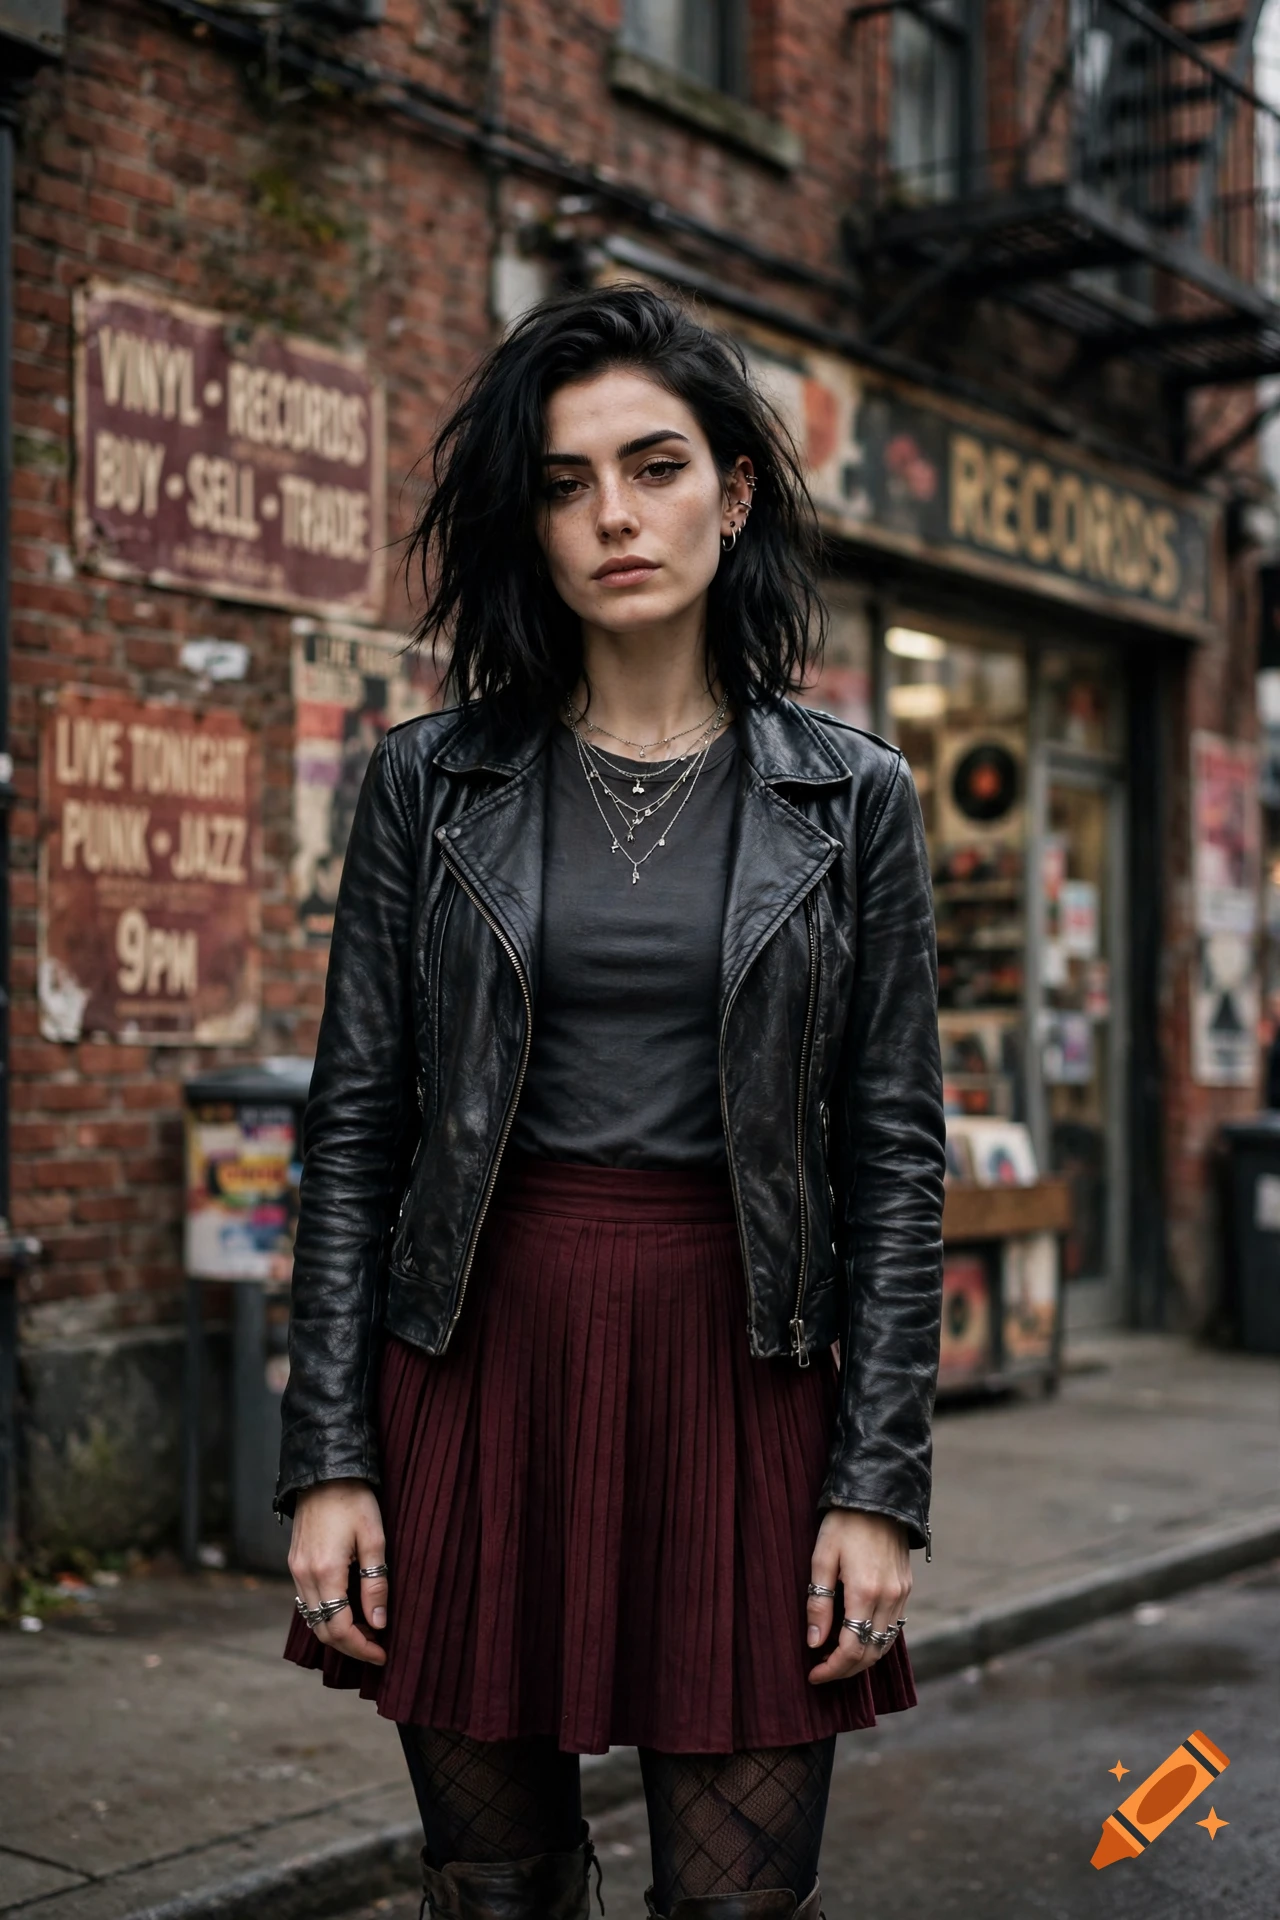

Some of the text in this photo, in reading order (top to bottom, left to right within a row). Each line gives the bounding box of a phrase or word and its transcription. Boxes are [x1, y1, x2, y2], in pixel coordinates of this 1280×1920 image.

[101, 328, 366, 464] VINYL RECORDS
[96, 434, 369, 560] BUY SELL TRADE
[950, 435, 1179, 595] RECORDS
[57, 718, 246, 799] LIVE TONIGHT
[63, 802, 246, 882] PUNK JAZZ
